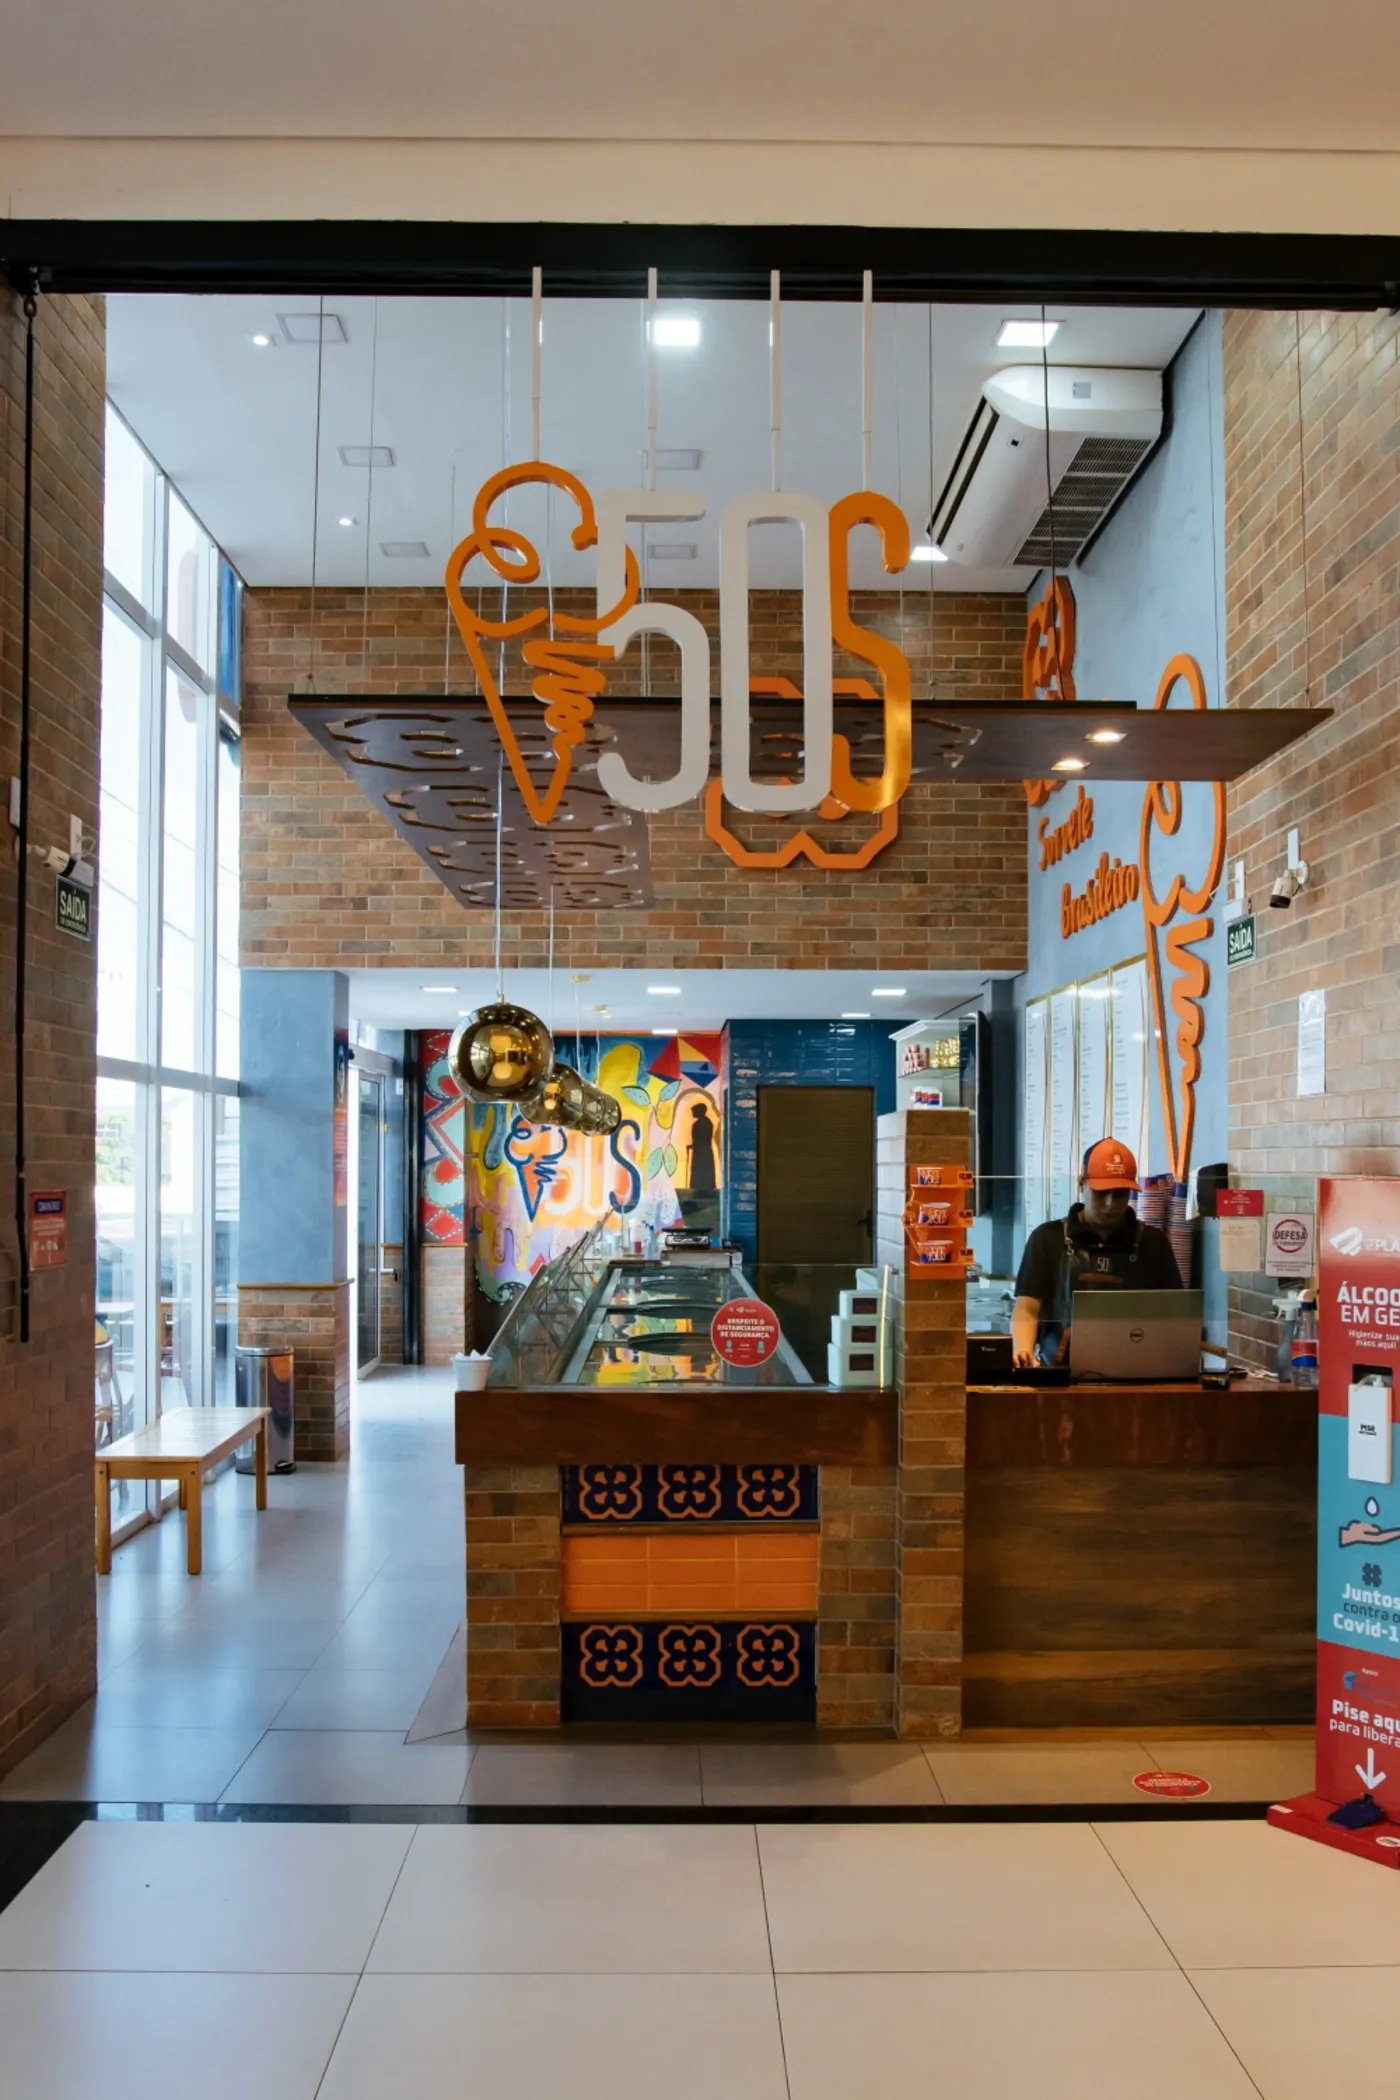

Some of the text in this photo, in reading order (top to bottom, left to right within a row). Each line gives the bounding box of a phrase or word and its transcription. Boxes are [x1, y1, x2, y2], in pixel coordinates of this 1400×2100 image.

[1038, 785, 1094, 871] Sorvete
[59, 889, 87, 924] SAÍDA
[1229, 923, 1253, 954] SAÍDA
[1274, 1230, 1306, 1240] DEFESA
[1341, 1304, 1370, 1324] EM
[1348, 1329, 1383, 1340] Higienize
[1343, 1602, 1389, 1621] contra
[1332, 1698, 1369, 1724] Pise
[1329, 1718, 1360, 1736] para
